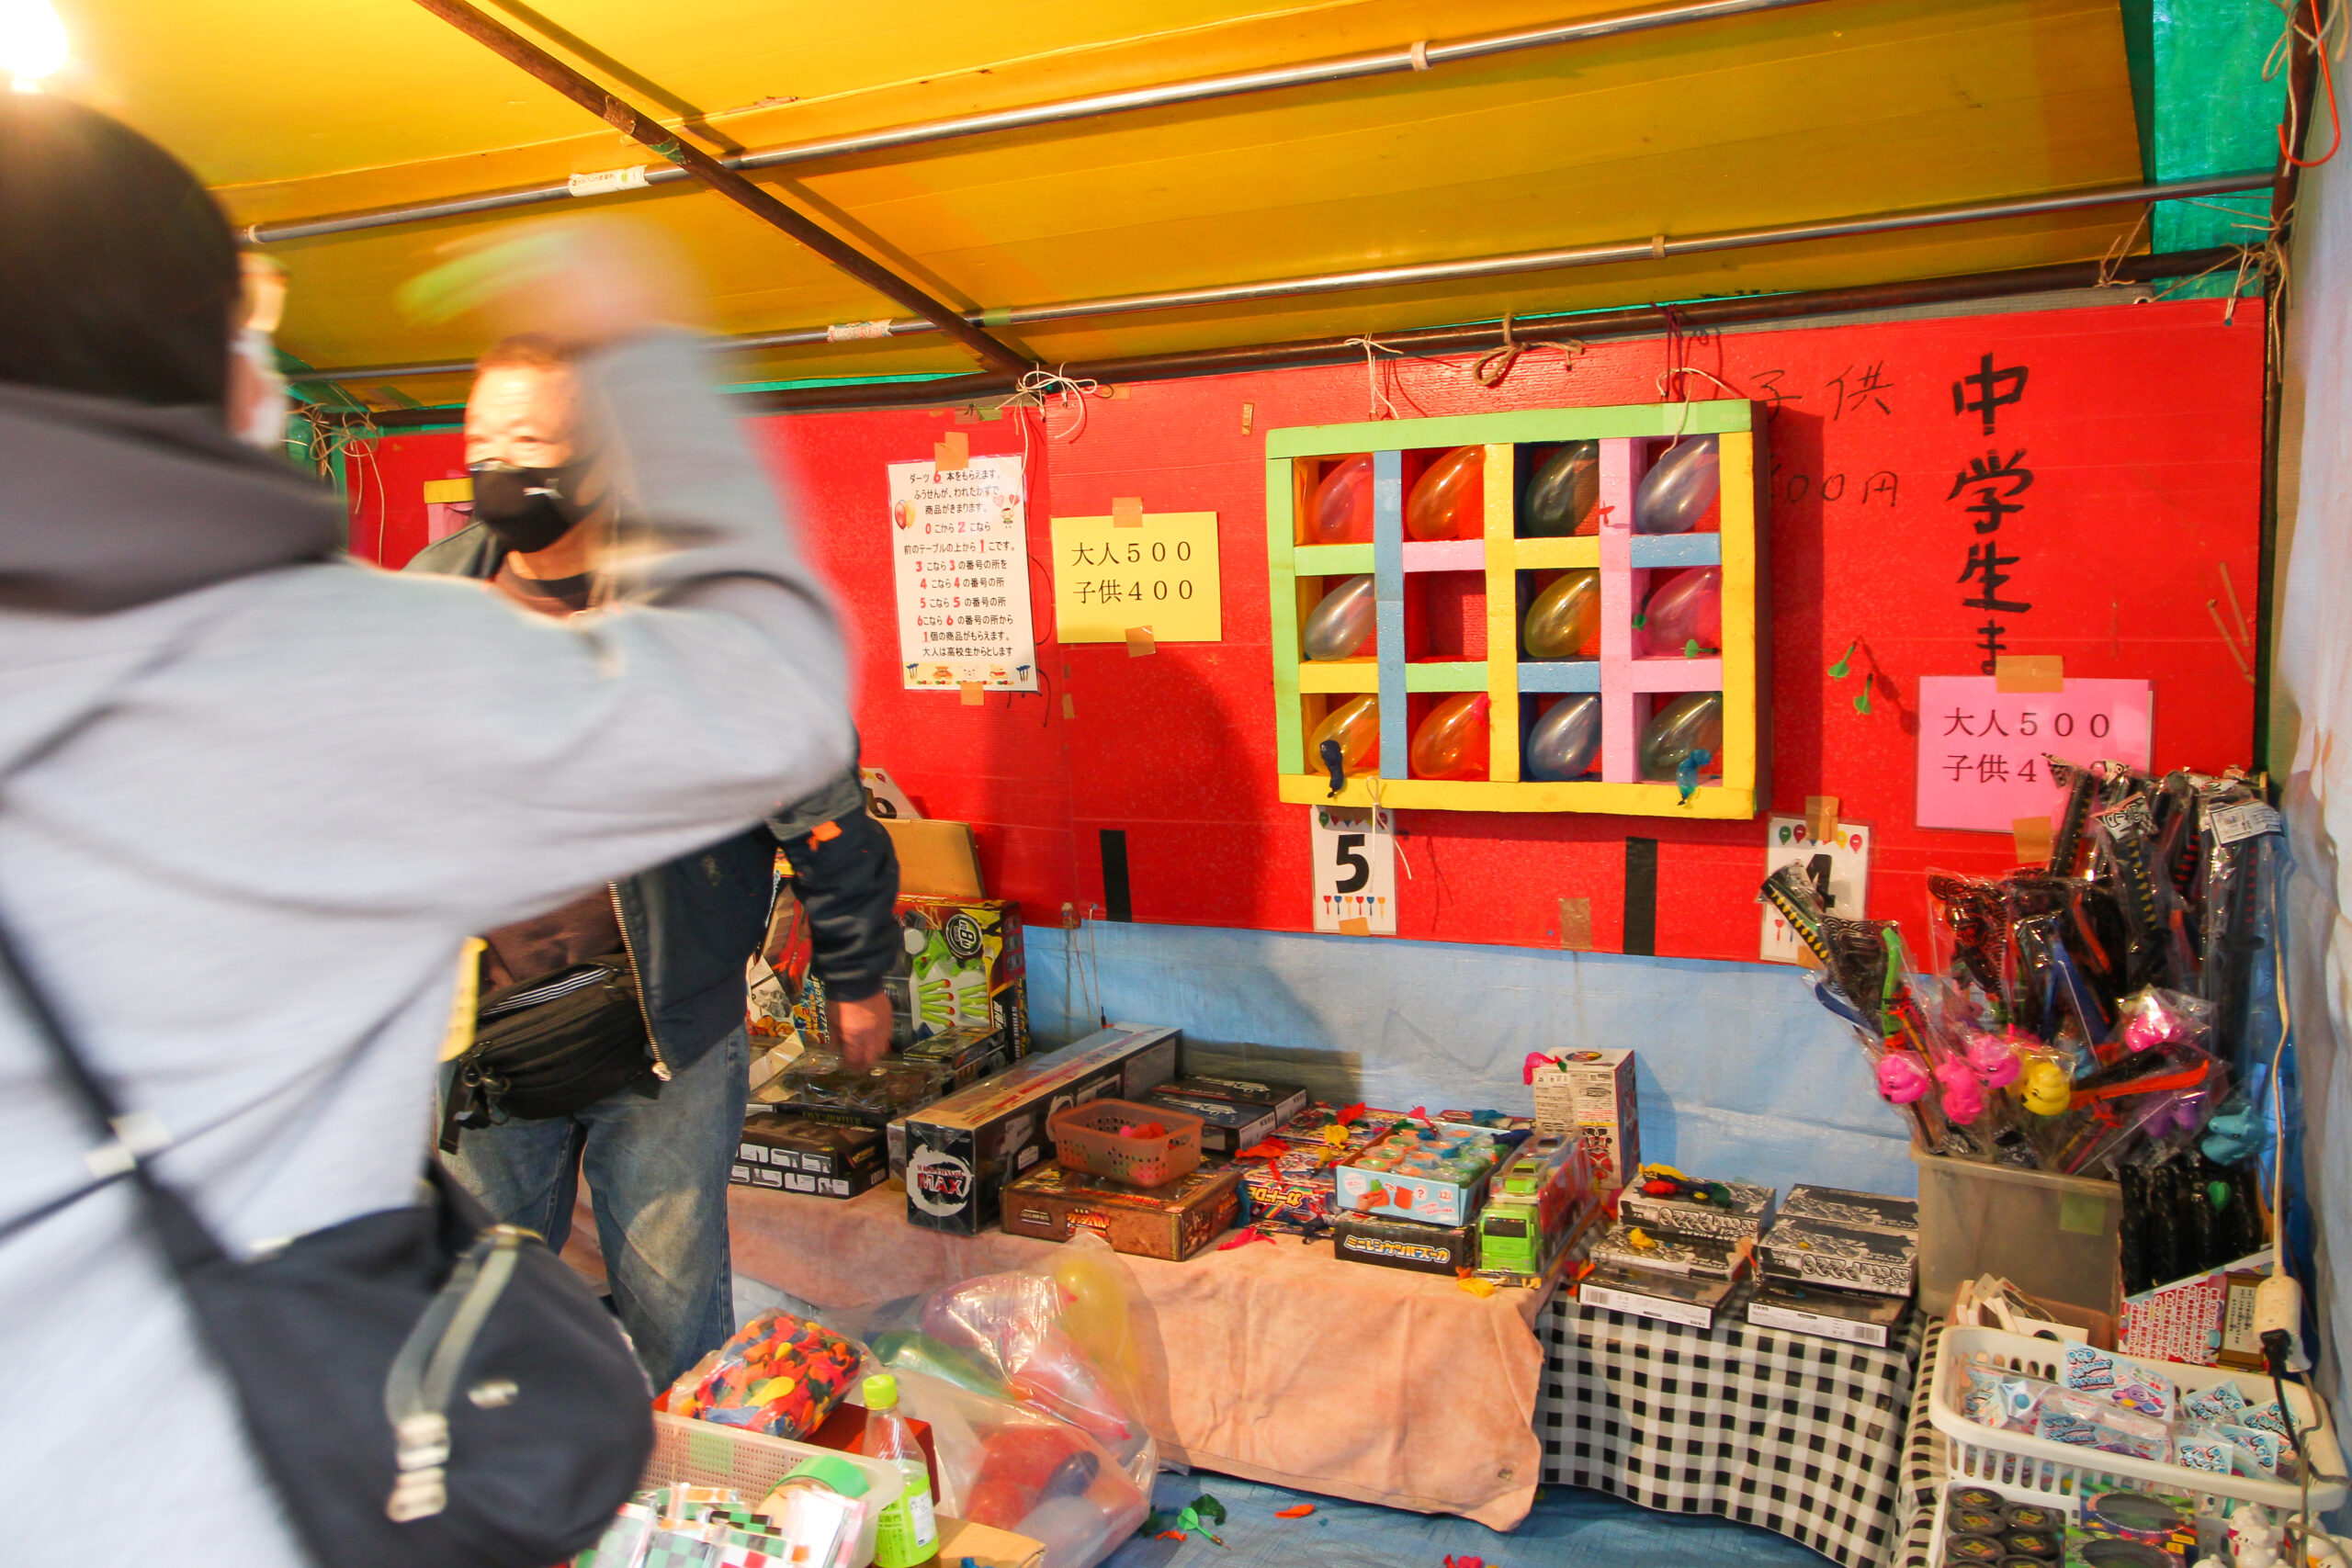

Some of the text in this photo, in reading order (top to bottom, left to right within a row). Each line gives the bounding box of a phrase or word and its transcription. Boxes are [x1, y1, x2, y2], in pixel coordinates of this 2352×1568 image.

[1770, 453, 1898, 508] 00円
[1336, 834, 1370, 894] 5
[918, 1173, 963, 1199] MAX
[2066, 1348, 2096, 1364] POP
